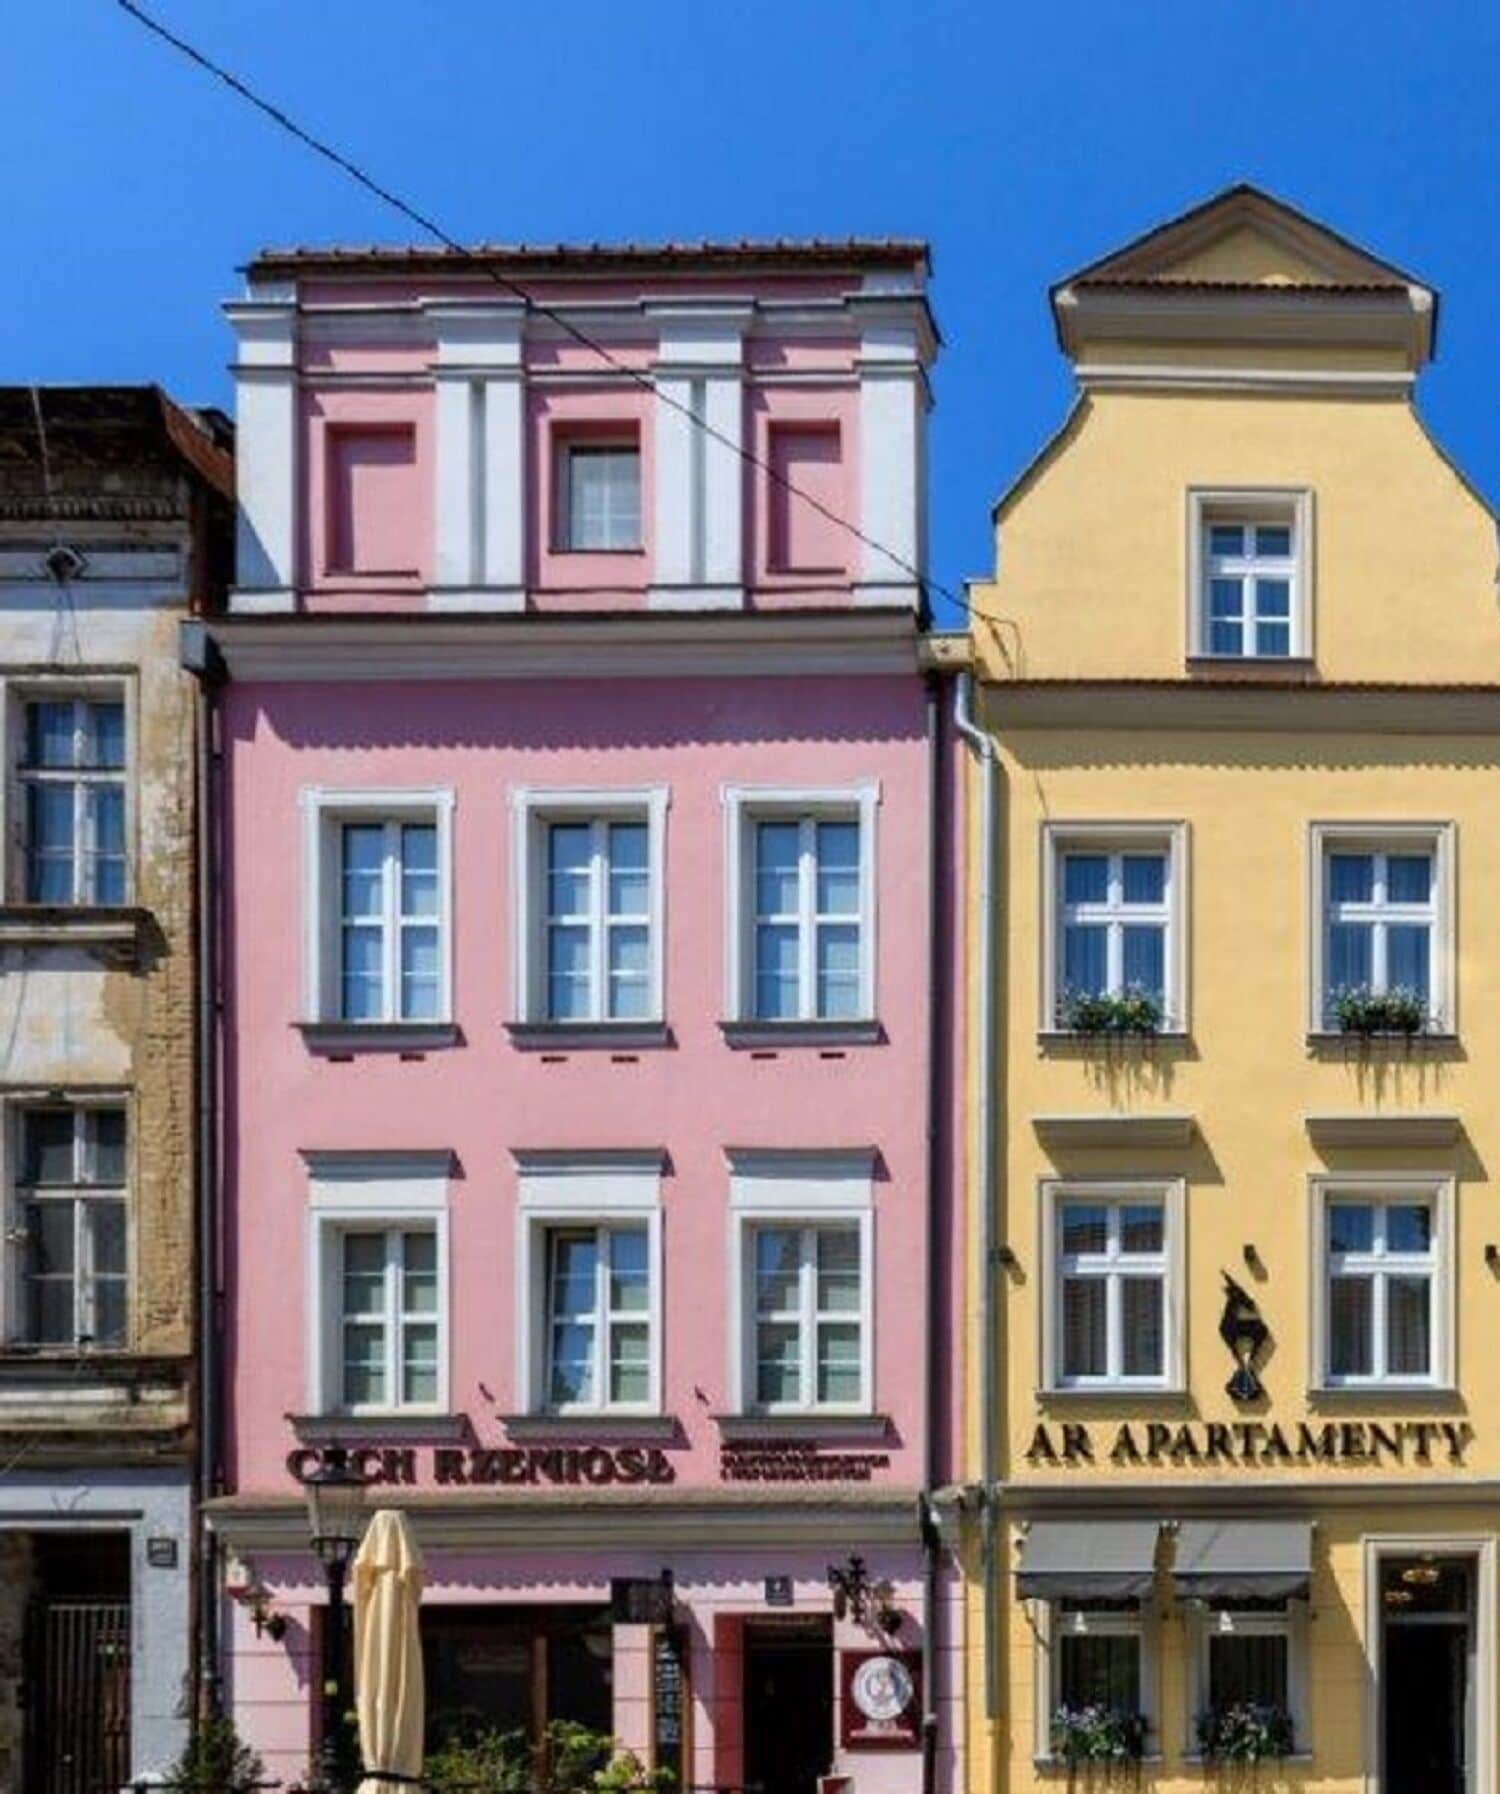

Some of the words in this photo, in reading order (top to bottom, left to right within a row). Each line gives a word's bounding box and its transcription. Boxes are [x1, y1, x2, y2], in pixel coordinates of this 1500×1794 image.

[1025, 1422, 1096, 1460] AR
[1109, 1422, 1473, 1460] APARTAMENTY
[286, 1449, 417, 1486] CCH
